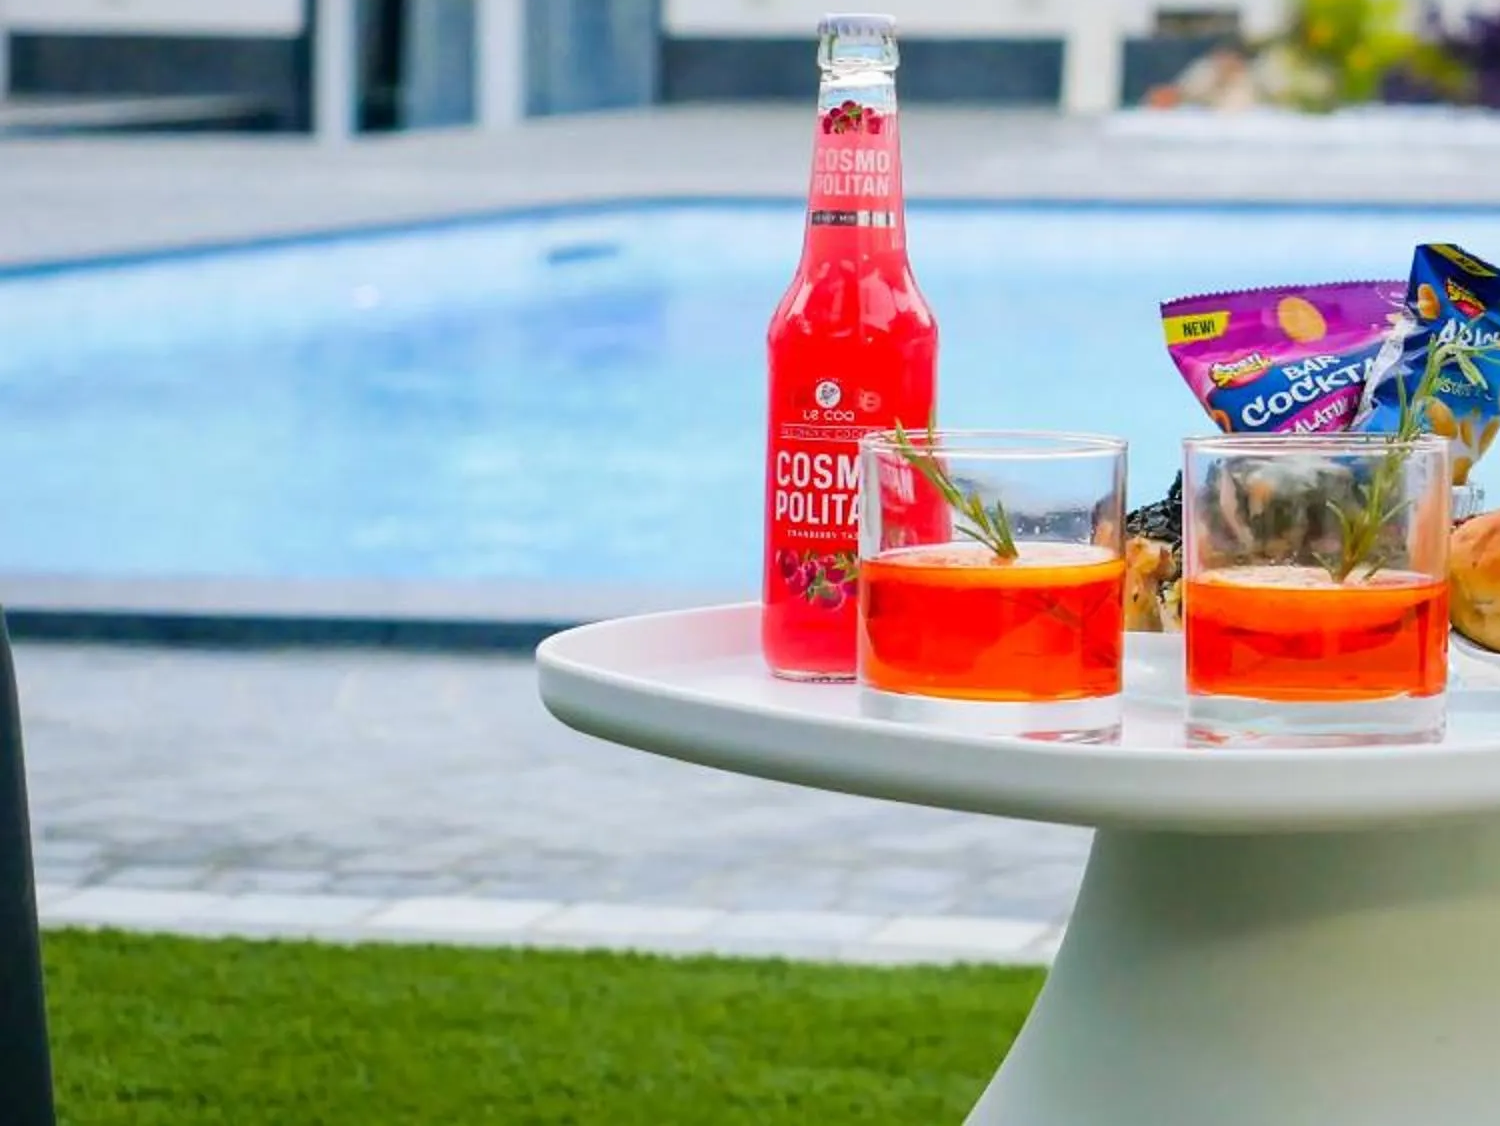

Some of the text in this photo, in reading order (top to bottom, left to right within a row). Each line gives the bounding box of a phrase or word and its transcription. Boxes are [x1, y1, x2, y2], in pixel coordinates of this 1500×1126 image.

[1182, 320, 1216, 337] NEW!
[1281, 355, 1340, 380] BAR
[776, 449, 863, 490] COSM
[774, 489, 862, 526] POLITA
